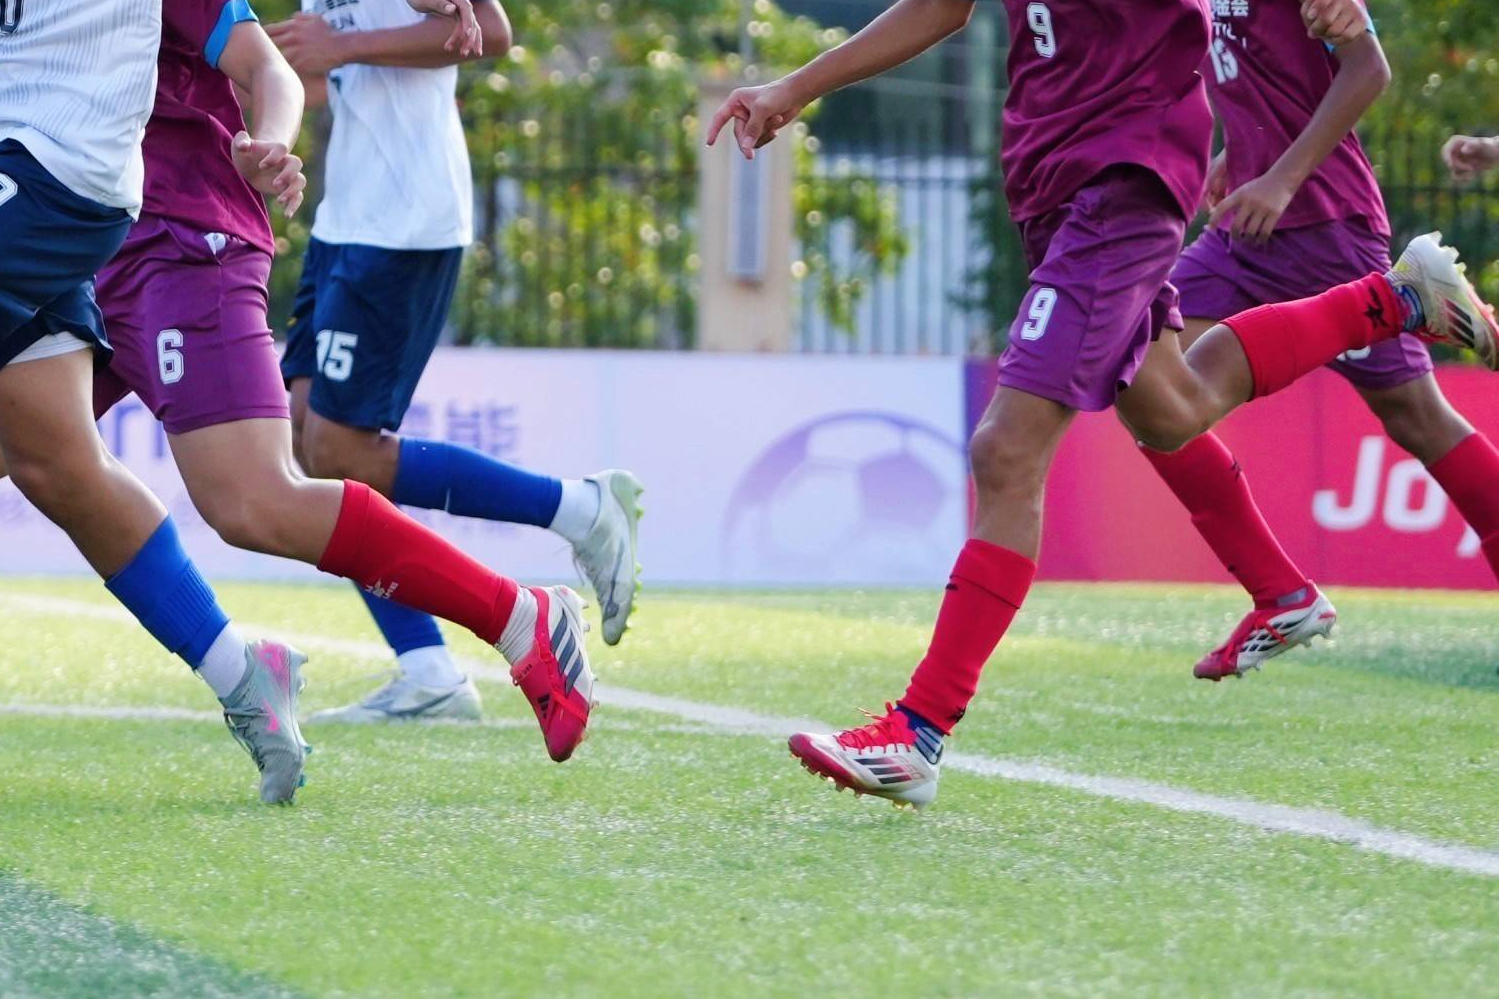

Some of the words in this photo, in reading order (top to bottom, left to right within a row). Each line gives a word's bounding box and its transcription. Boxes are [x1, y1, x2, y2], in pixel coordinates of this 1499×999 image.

[1026, 1, 1056, 58] 9
[1020, 287, 1058, 341] 9
[156, 328, 185, 385] 6
[316, 329, 359, 383] 15
